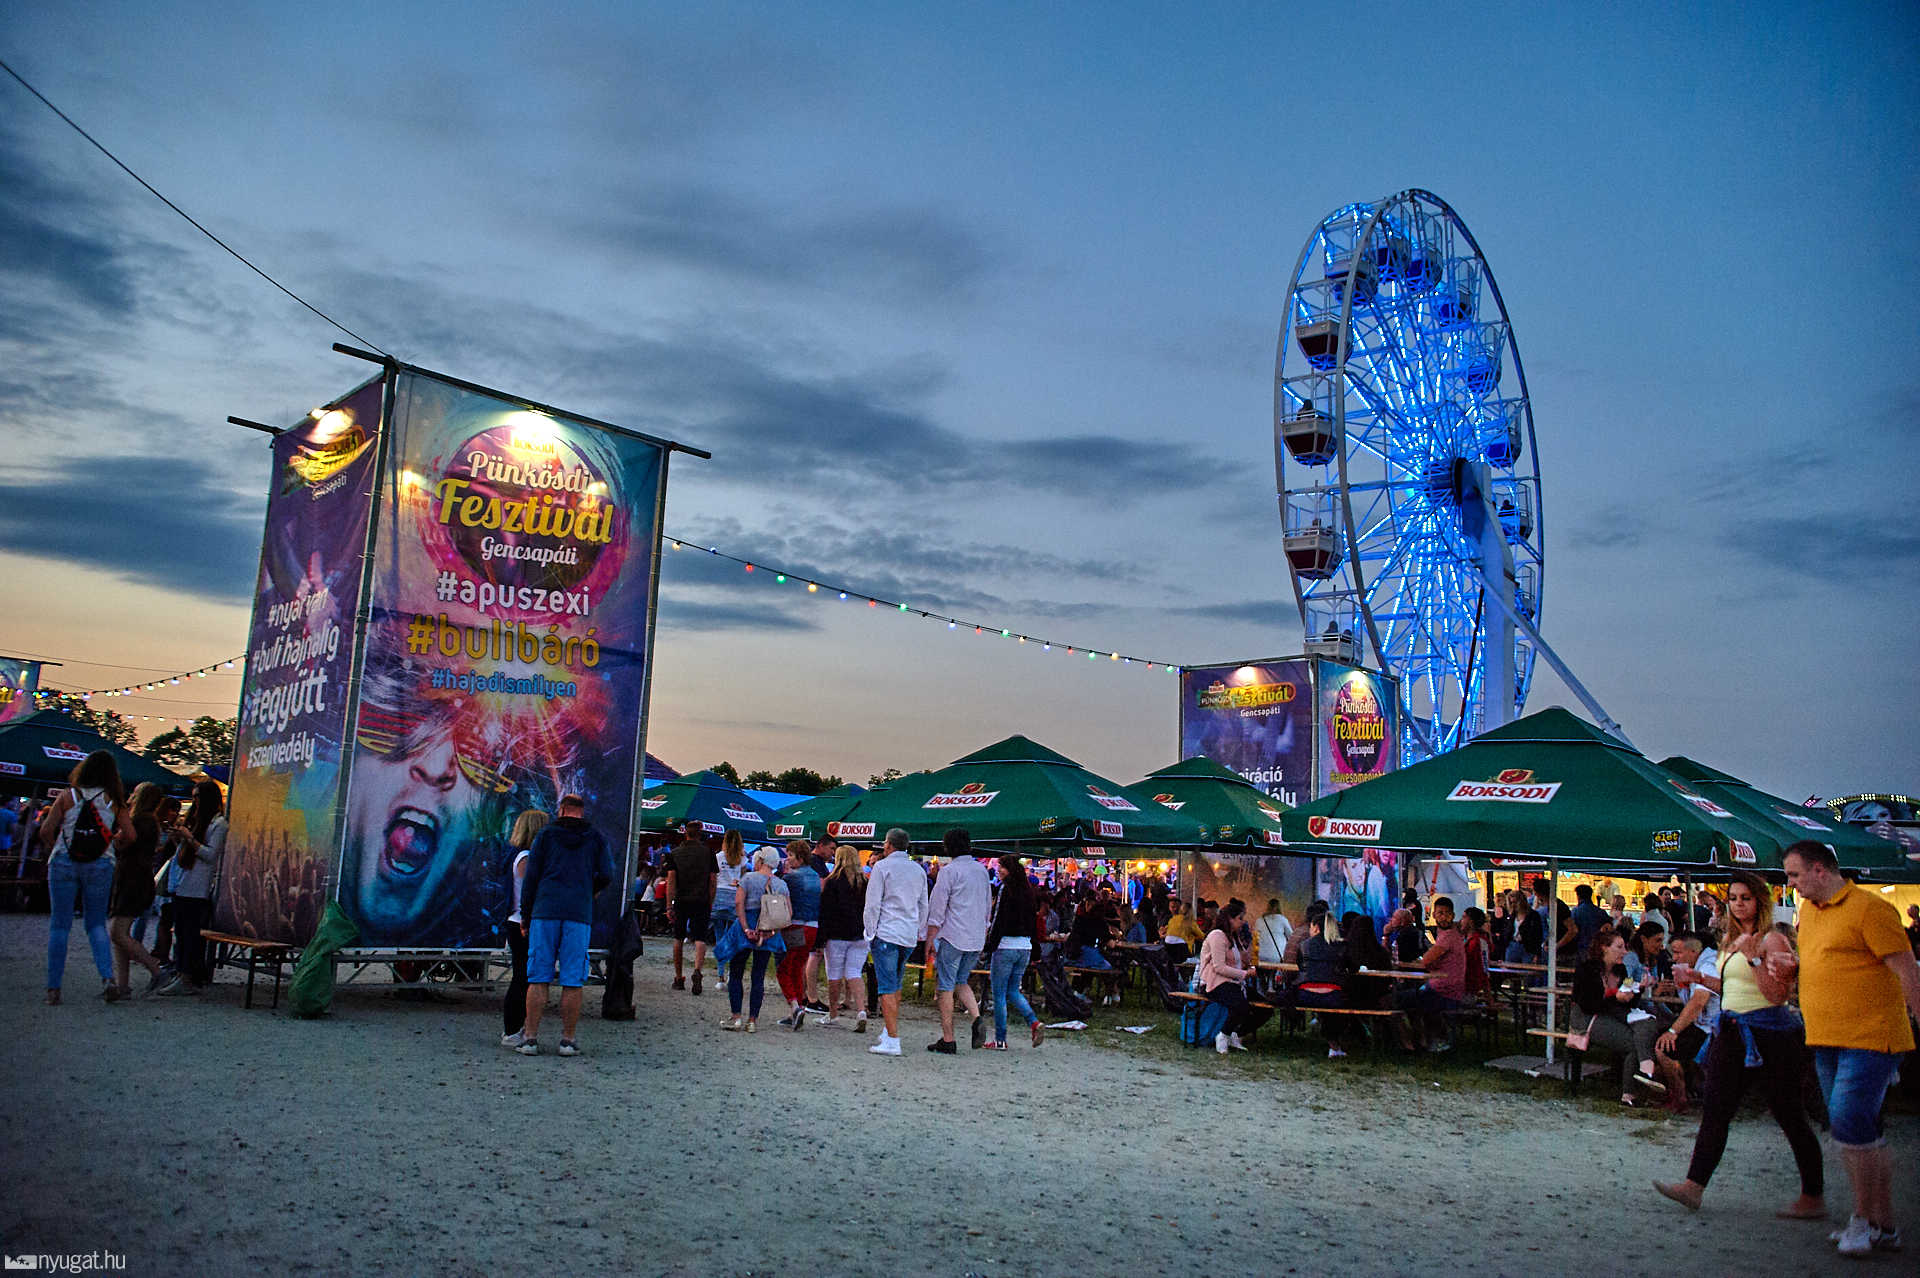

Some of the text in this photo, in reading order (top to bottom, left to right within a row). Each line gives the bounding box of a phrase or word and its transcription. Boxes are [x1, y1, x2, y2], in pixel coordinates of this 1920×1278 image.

[467, 450, 591, 493] Pünkösdi
[435, 478, 614, 544] Fesztivál
[480, 536, 578, 568] Gencsapáti
[436, 571, 590, 616] #apuszexi
[280, 618, 340, 672] hajnalig
[407, 613, 600, 668] #bulibáró
[431, 668, 577, 700] #hajadismilyen
[250, 667, 328, 735] #együtt
[1240, 706, 1281, 718] Gencsapáti
[1333, 714, 1385, 740] Fesztivál
[247, 731, 315, 769] #szenvedély
[929, 794, 993, 805] BORSODI
[1456, 785, 1552, 799] BORSODI
[784, 826, 802, 835] BORSODI
[841, 824, 873, 837] BORSODI
[1330, 821, 1377, 837] BORSODI
